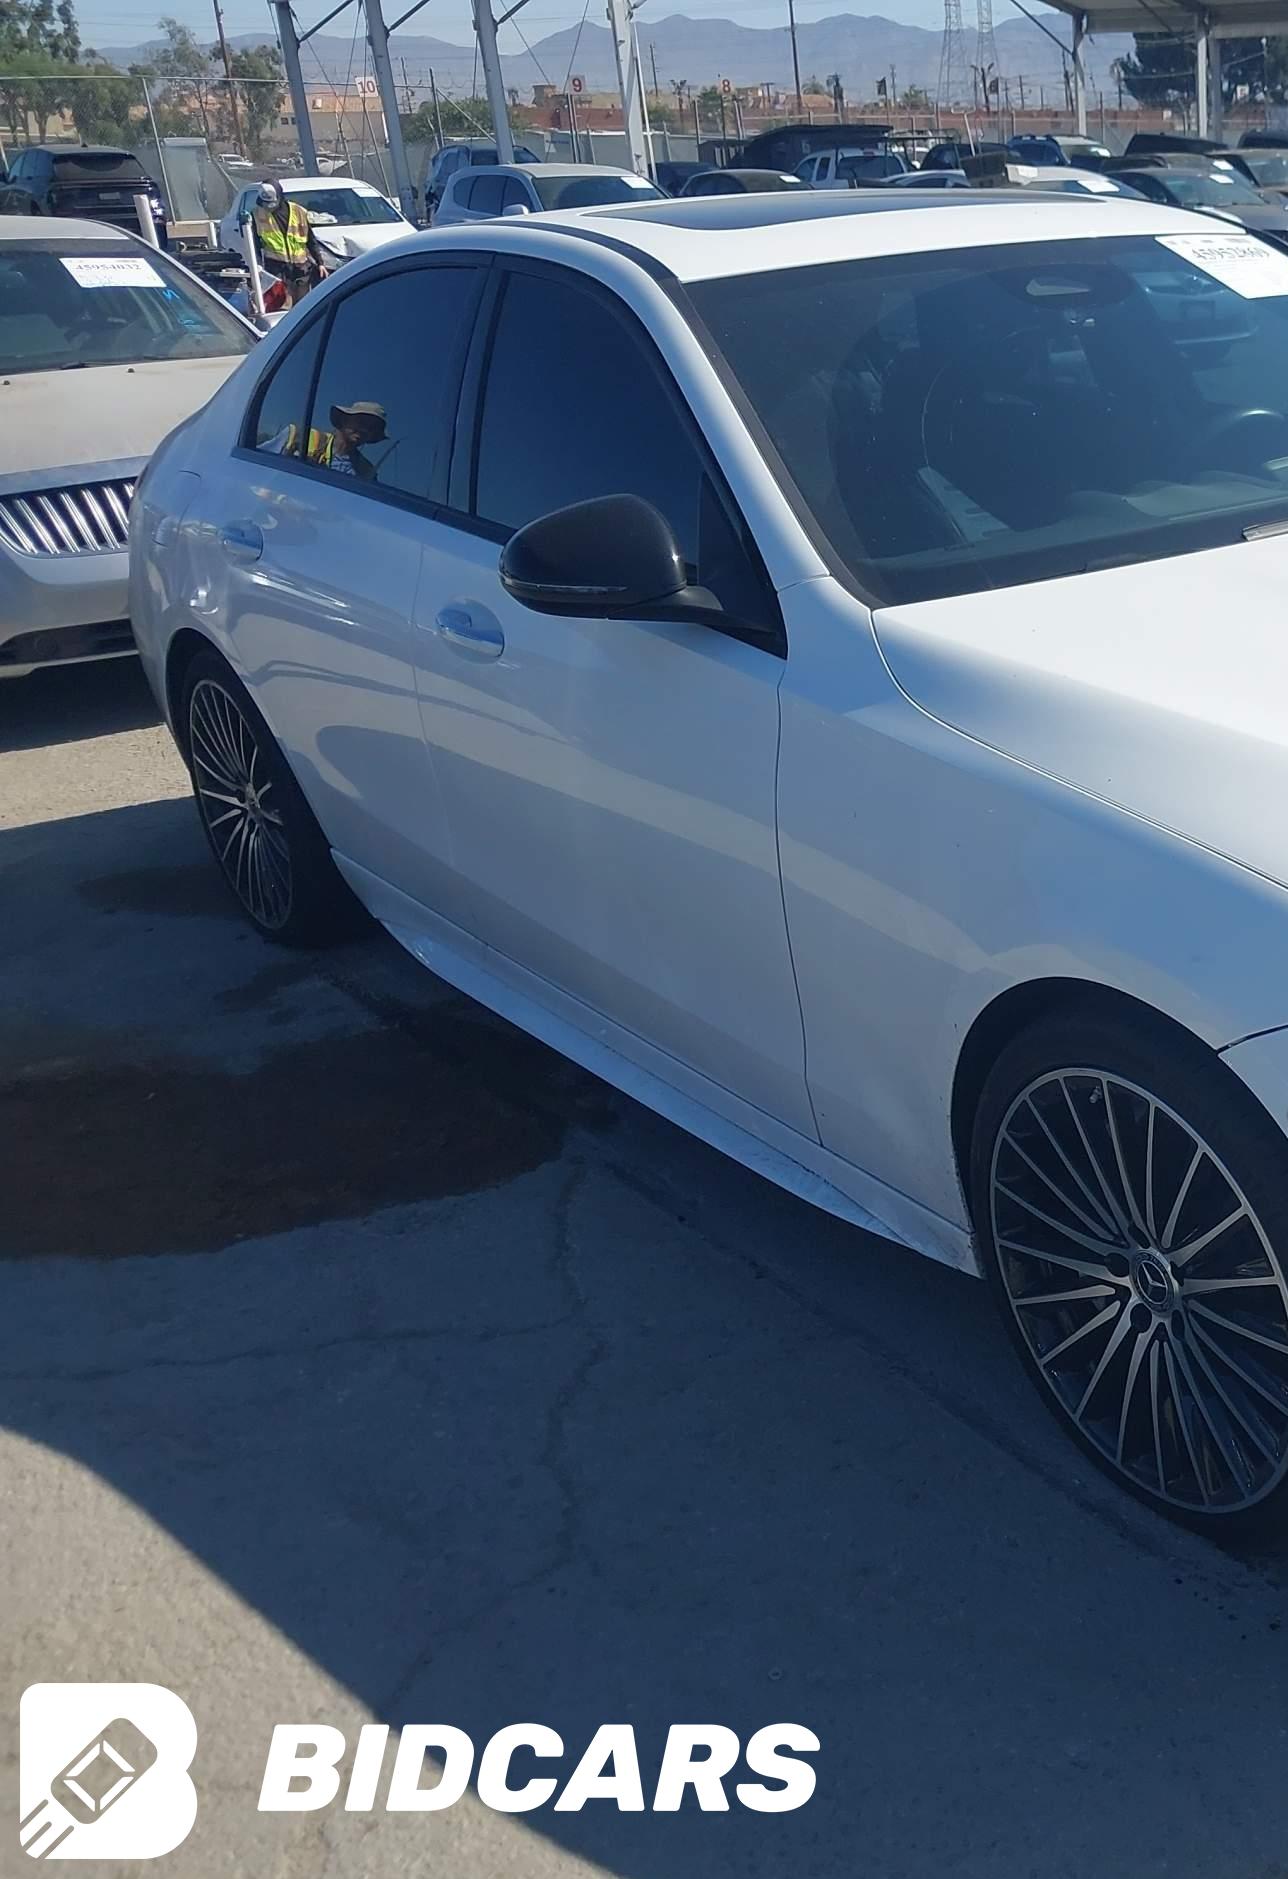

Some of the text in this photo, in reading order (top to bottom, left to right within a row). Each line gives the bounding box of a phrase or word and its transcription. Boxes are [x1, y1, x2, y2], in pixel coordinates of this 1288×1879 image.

[357, 80, 376, 94] 10
[572, 78, 583, 93] 9
[722, 79, 731, 94] 8
